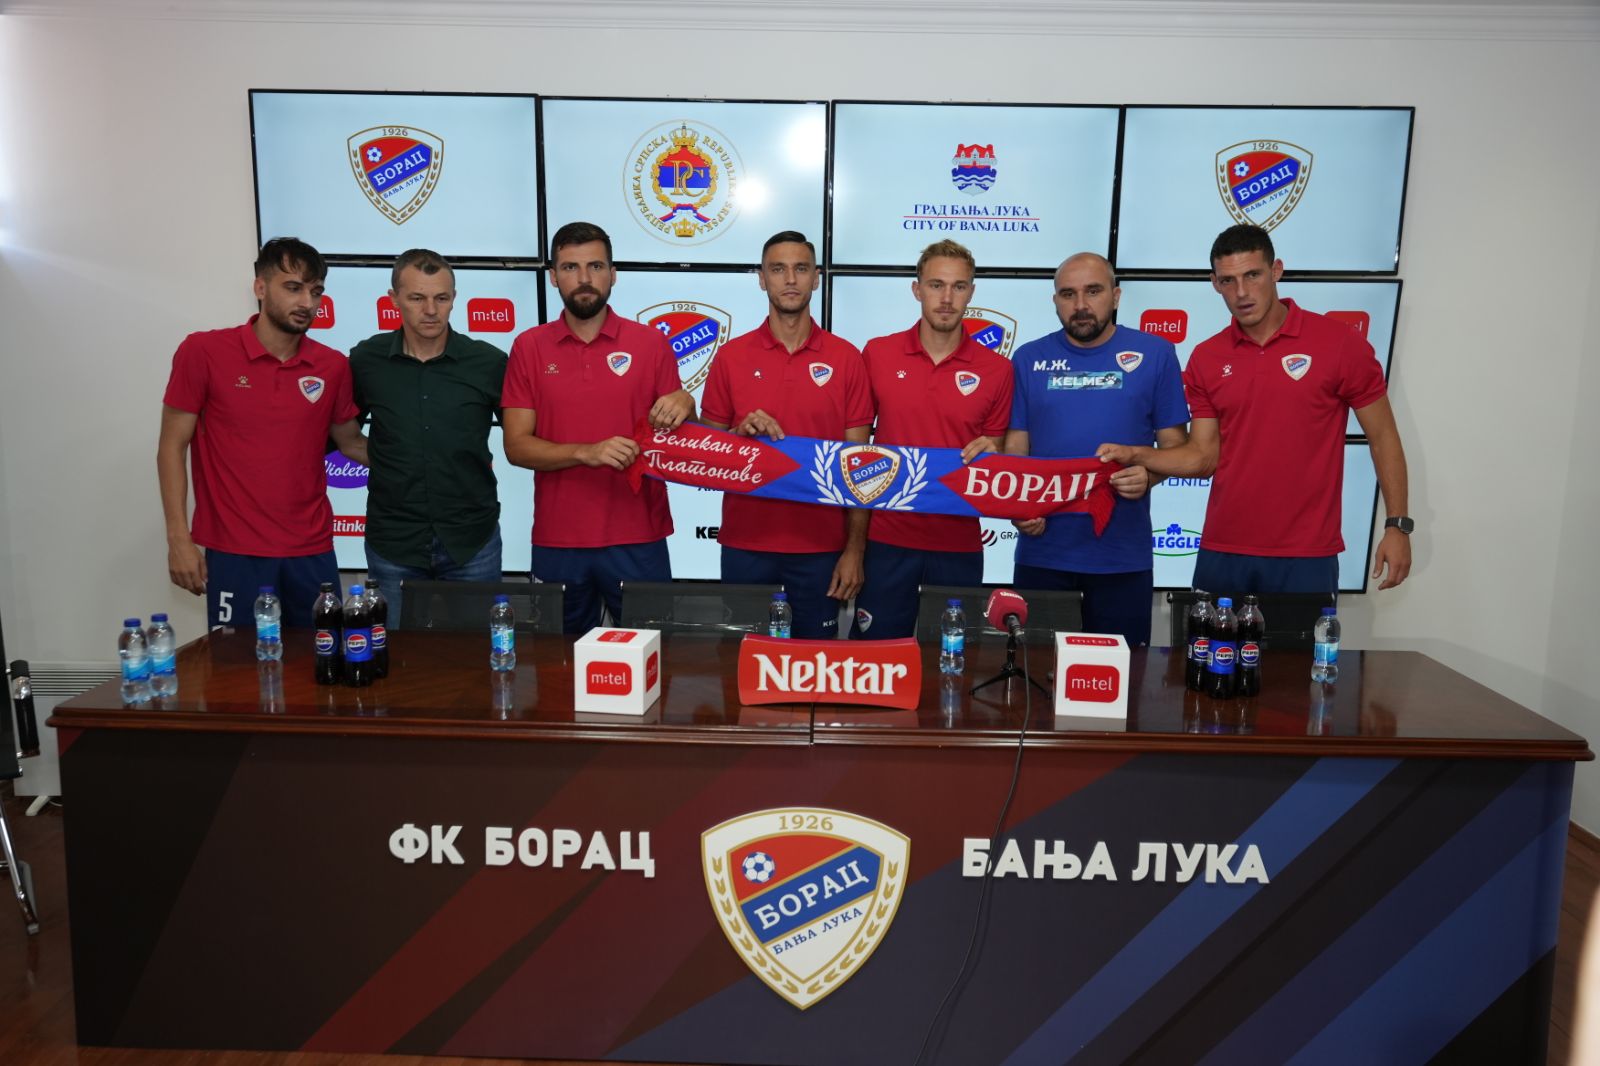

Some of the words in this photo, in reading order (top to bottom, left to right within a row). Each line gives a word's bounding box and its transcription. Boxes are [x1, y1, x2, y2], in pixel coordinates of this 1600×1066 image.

[382, 128, 408, 137] 1926
[634, 135, 669, 174] СРПСКА
[1252, 142, 1279, 151] 1926
[373, 150, 427, 186] БОРАЦ
[383, 185, 405, 199] БАЊА
[405, 174, 425, 188] ЛУКА
[1237, 164, 1294, 201] БОРАЦ
[914, 204, 947, 216] ГРАД
[951, 204, 990, 217] БАЊА
[992, 205, 1030, 217] ЛУКА
[1244, 199, 1268, 214] БАЊА
[1269, 188, 1289, 202] ЛУКА
[903, 219, 936, 231] CITY
[938, 220, 957, 231] OF
[959, 221, 1000, 232] BANJA
[1003, 222, 1040, 232] LUKA
[473, 308, 510, 322] m:tel
[671, 303, 697, 312] 1926
[963, 309, 983, 318] 926
[1144, 319, 1182, 334] m:tel
[672, 325, 714, 353] ОРАЦ
[692, 347, 712, 362] ЛУКА
[1033, 359, 1071, 371] М.Ж.
[1052, 376, 1105, 387] KELME
[653, 427, 734, 454] Великан
[738, 444, 761, 463] из
[643, 449, 763, 484] Платонове
[852, 460, 890, 481] БОРАЦ
[963, 466, 1099, 503] БОРАЦ
[332, 519, 366, 532] itink
[1000, 530, 1019, 540] GRA
[218, 591, 234, 623] 5
[591, 671, 627, 686] m:tel
[752, 651, 908, 695] Nektar
[1071, 675, 1113, 691] m:tel
[778, 814, 834, 831] 1926
[388, 823, 465, 865] ФК
[485, 826, 655, 878] БОРАЦ
[961, 837, 1118, 881] БАЊА
[1131, 842, 1271, 884] ЛУКА
[753, 860, 870, 931] БОРАЦ
[772, 928, 818, 956] БАЊА
[821, 906, 864, 933] ЛУКА
